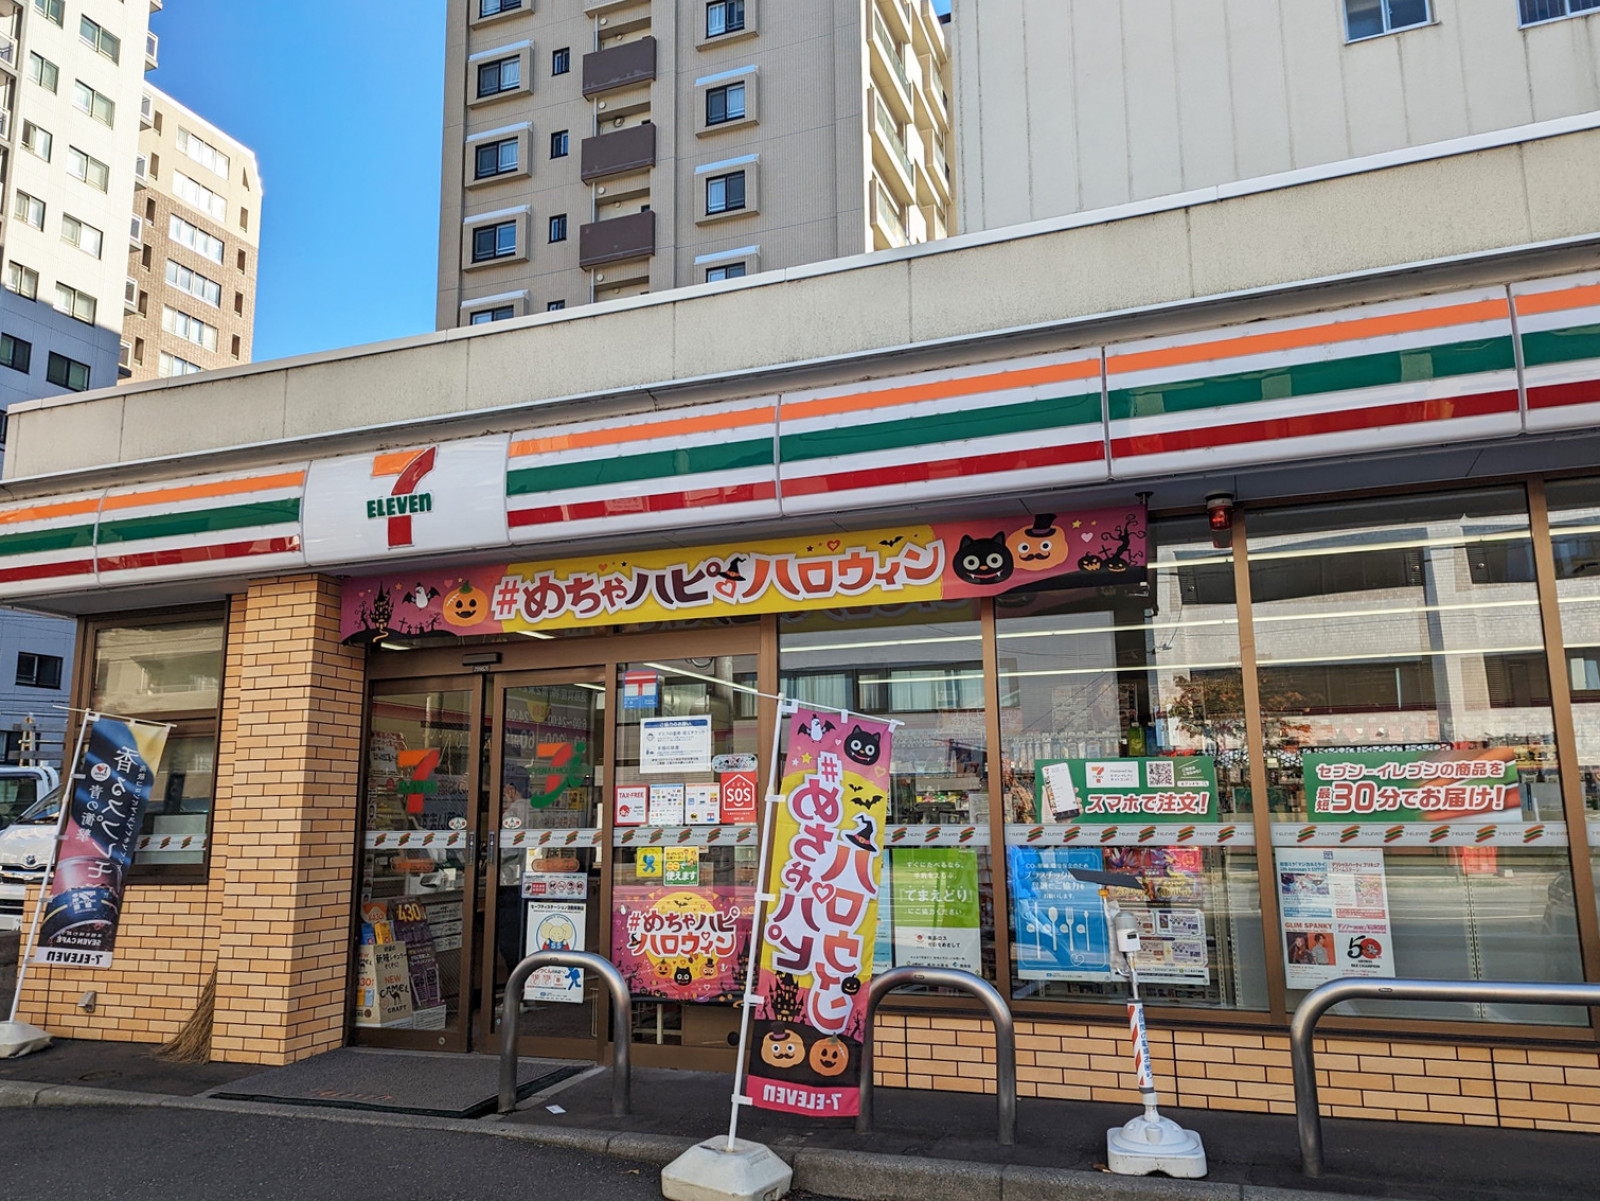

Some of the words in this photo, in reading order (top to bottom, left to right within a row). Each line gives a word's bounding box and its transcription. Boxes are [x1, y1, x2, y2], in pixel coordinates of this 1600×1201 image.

[727, 788, 751, 802] SOS
[1086, 793, 1209, 813] スマホで注文!
[666, 871, 697, 881] 使えます
